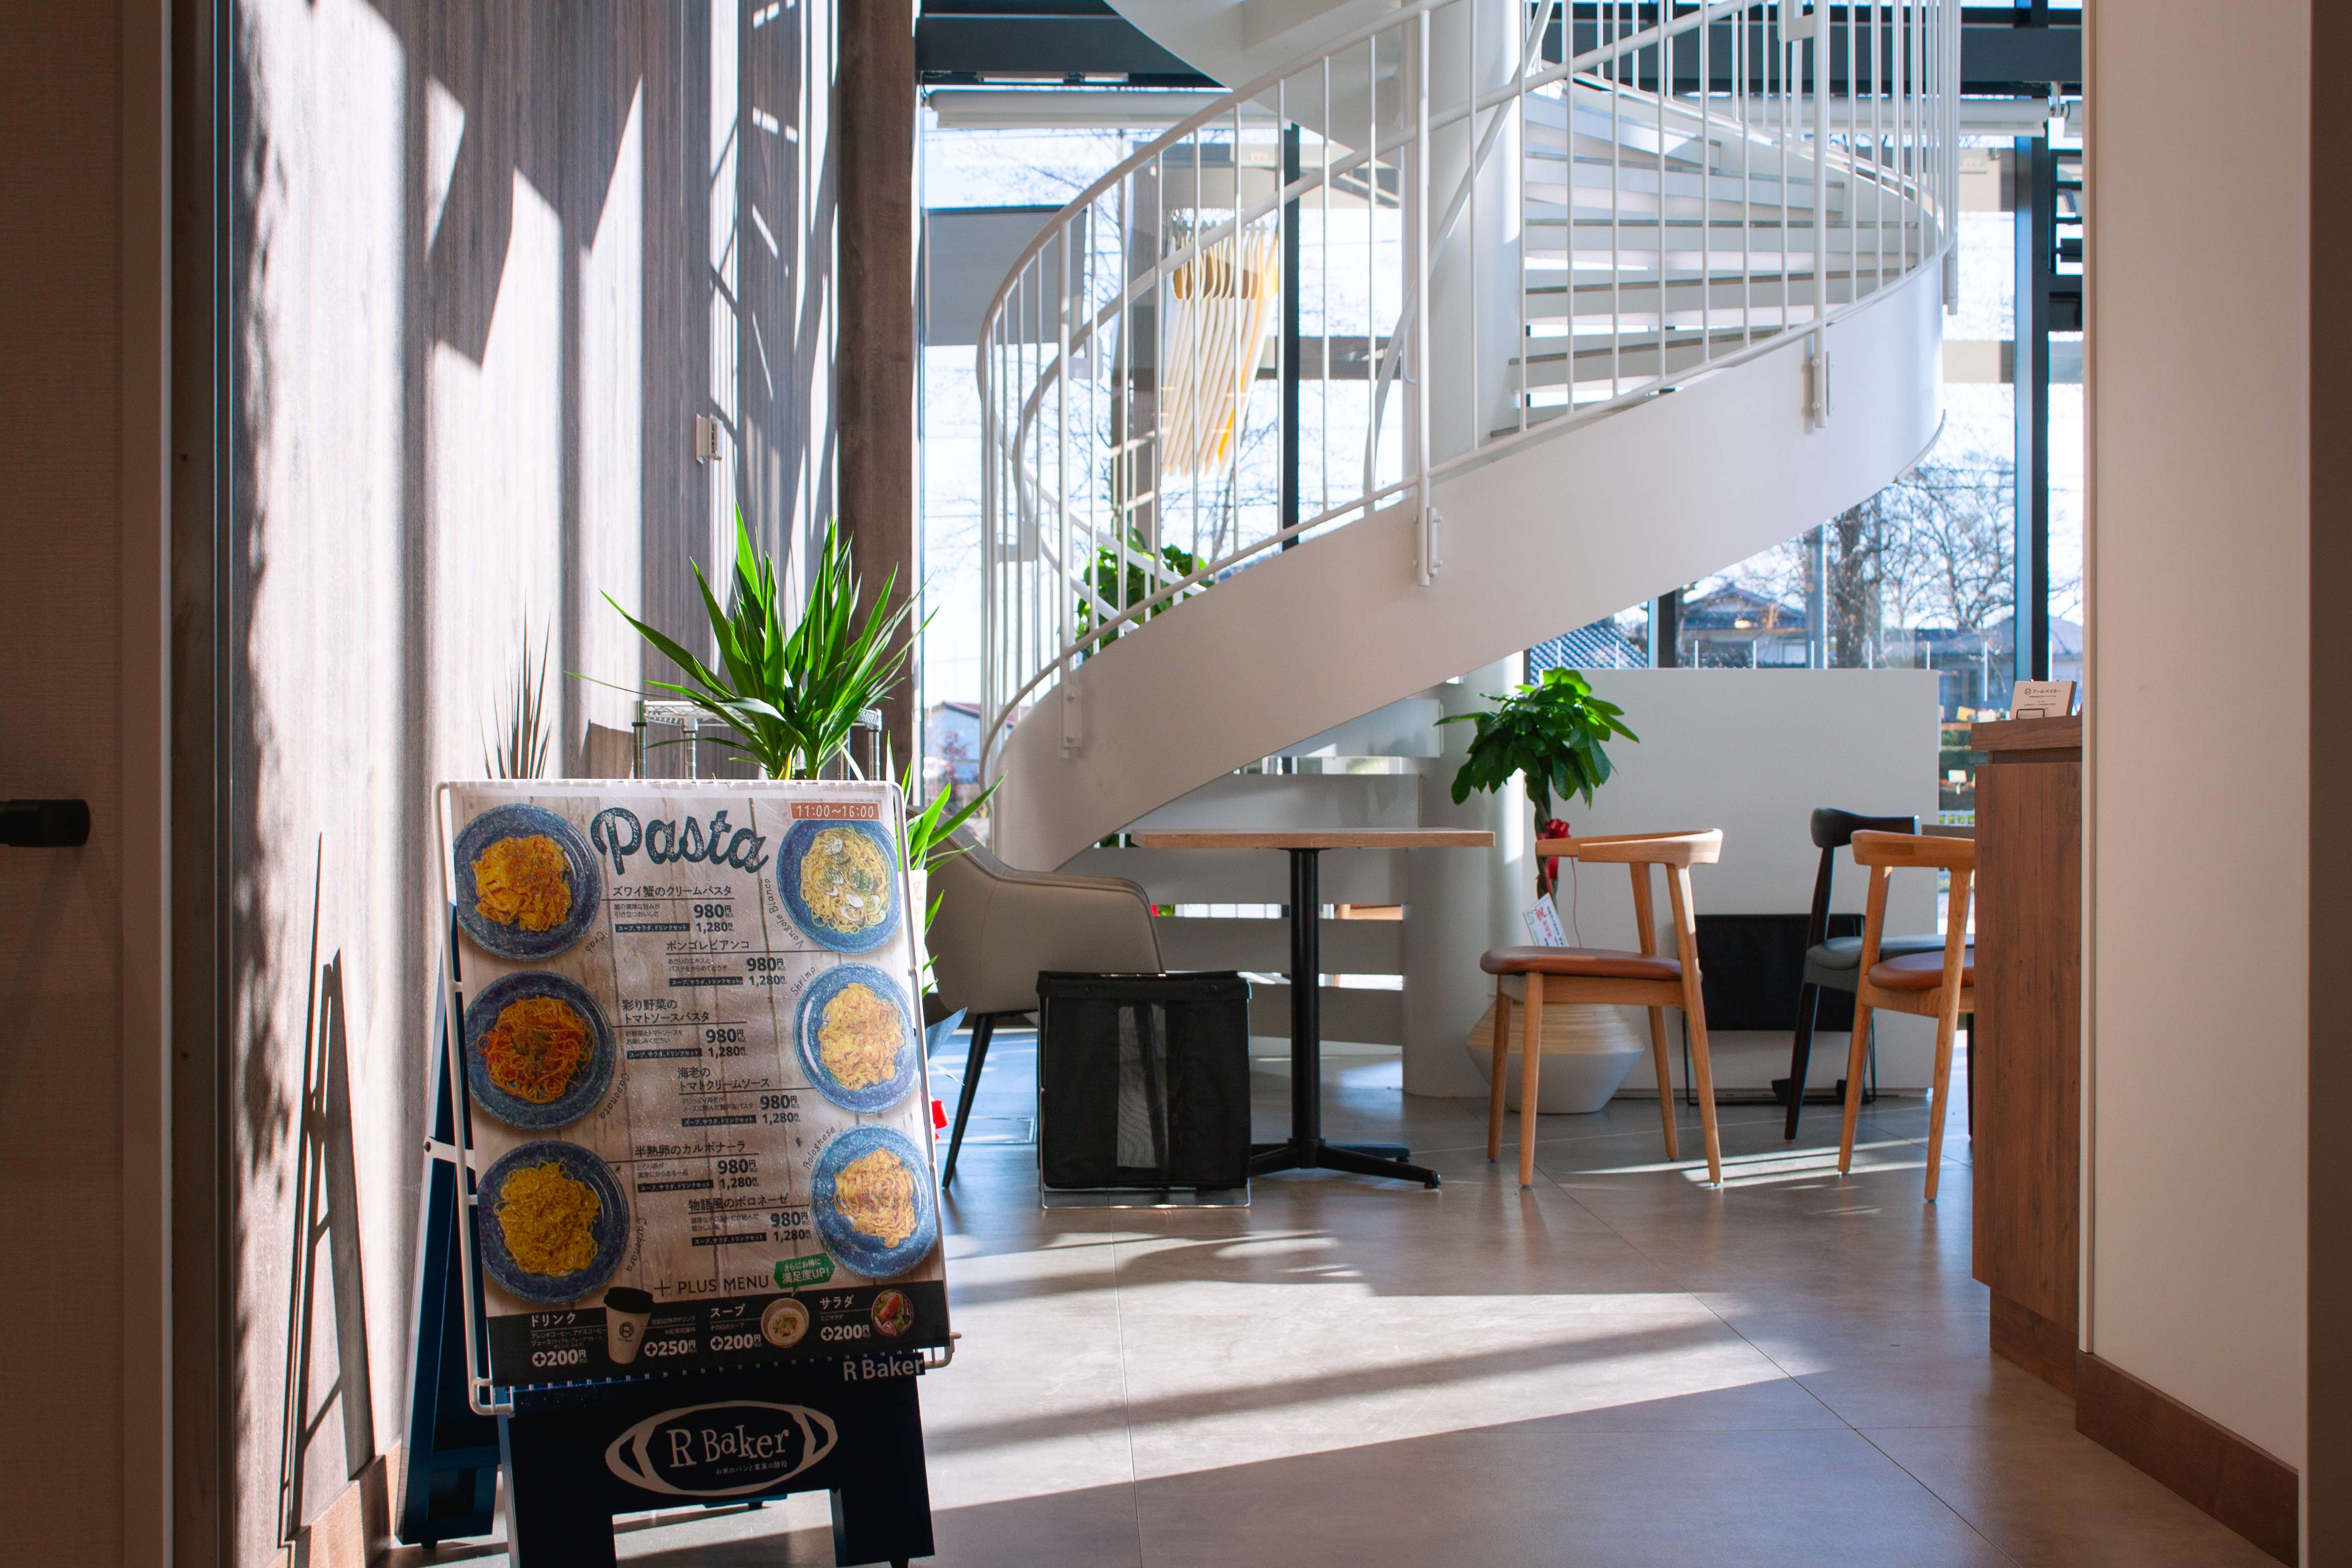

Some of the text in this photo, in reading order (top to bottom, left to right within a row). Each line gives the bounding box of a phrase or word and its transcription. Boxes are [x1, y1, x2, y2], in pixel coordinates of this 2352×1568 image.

[590, 807, 769, 876] Pasta
[613, 885, 732, 897] ズワイ蟹のクリームパスタ
[764, 879, 779, 914] Bianco
[585, 931, 604, 953] Crab
[666, 940, 749, 951] ボンゴレビアンコ
[791, 966, 816, 996] Shrimp
[622, 998, 678, 1011] 彩り野菜の
[626, 1012, 709, 1024] トマトソースパスタ
[678, 1067, 710, 1078] 海老の
[680, 1078, 771, 1091] トマトクリームソース
[598, 1073, 630, 1119] Caponata
[636, 1141, 745, 1158] 半熟卵のカルボナーラ
[803, 1126, 835, 1170] Bolognese
[688, 1193, 788, 1212] 物語風のボロネーゼ
[626, 1218, 647, 1272] Carbonara
[678, 1279, 717, 1294] PLUS
[724, 1275, 768, 1291] MENU
[711, 1303, 746, 1318] スープ
[820, 1294, 854, 1310] サラダ
[531, 1312, 576, 1327] ドリンク
[843, 1356, 924, 1381] R Baker
[666, 1425, 789, 1468] R Baker
